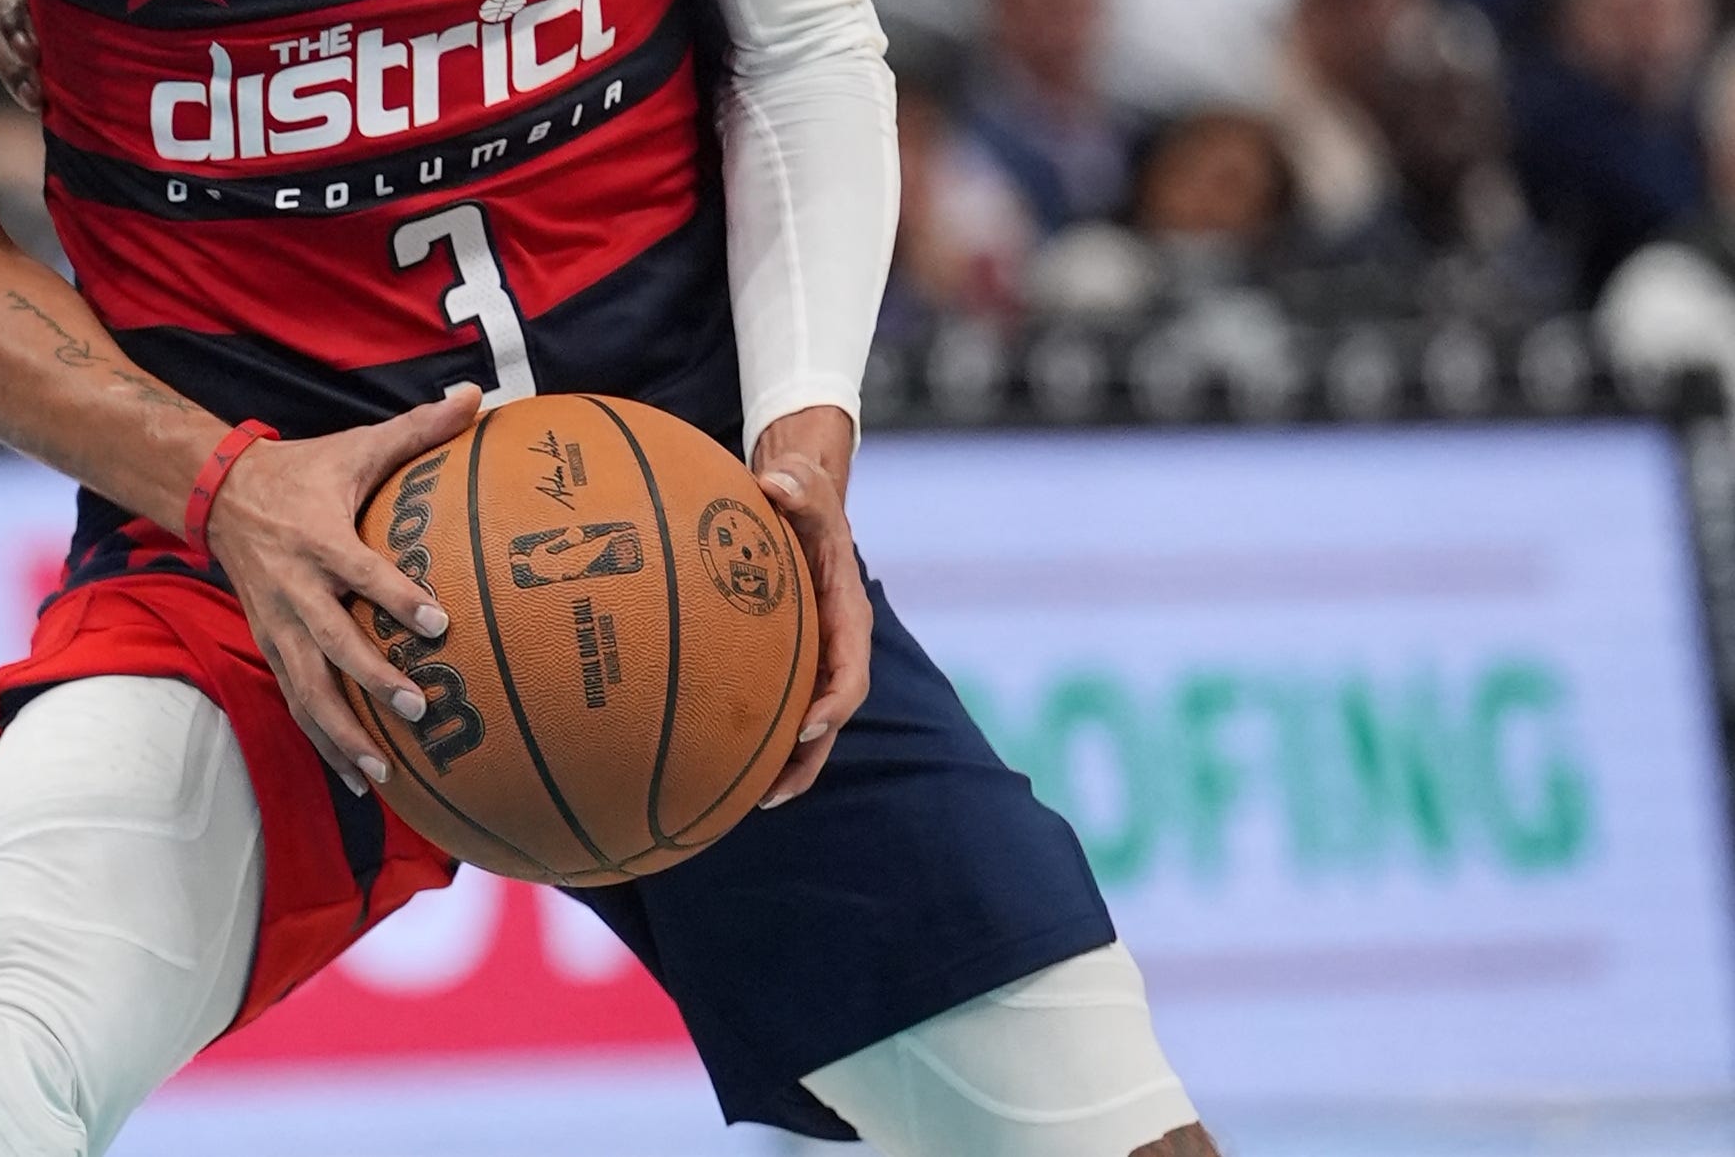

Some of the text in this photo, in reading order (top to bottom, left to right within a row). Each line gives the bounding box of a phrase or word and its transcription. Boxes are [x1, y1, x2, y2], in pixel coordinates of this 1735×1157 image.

[269, 22, 353, 66] THE
[275, 79, 622, 210] COLUMBIA
[393, 199, 537, 413] 3
[572, 596, 607, 709] OFFICIAL GAME BALL
